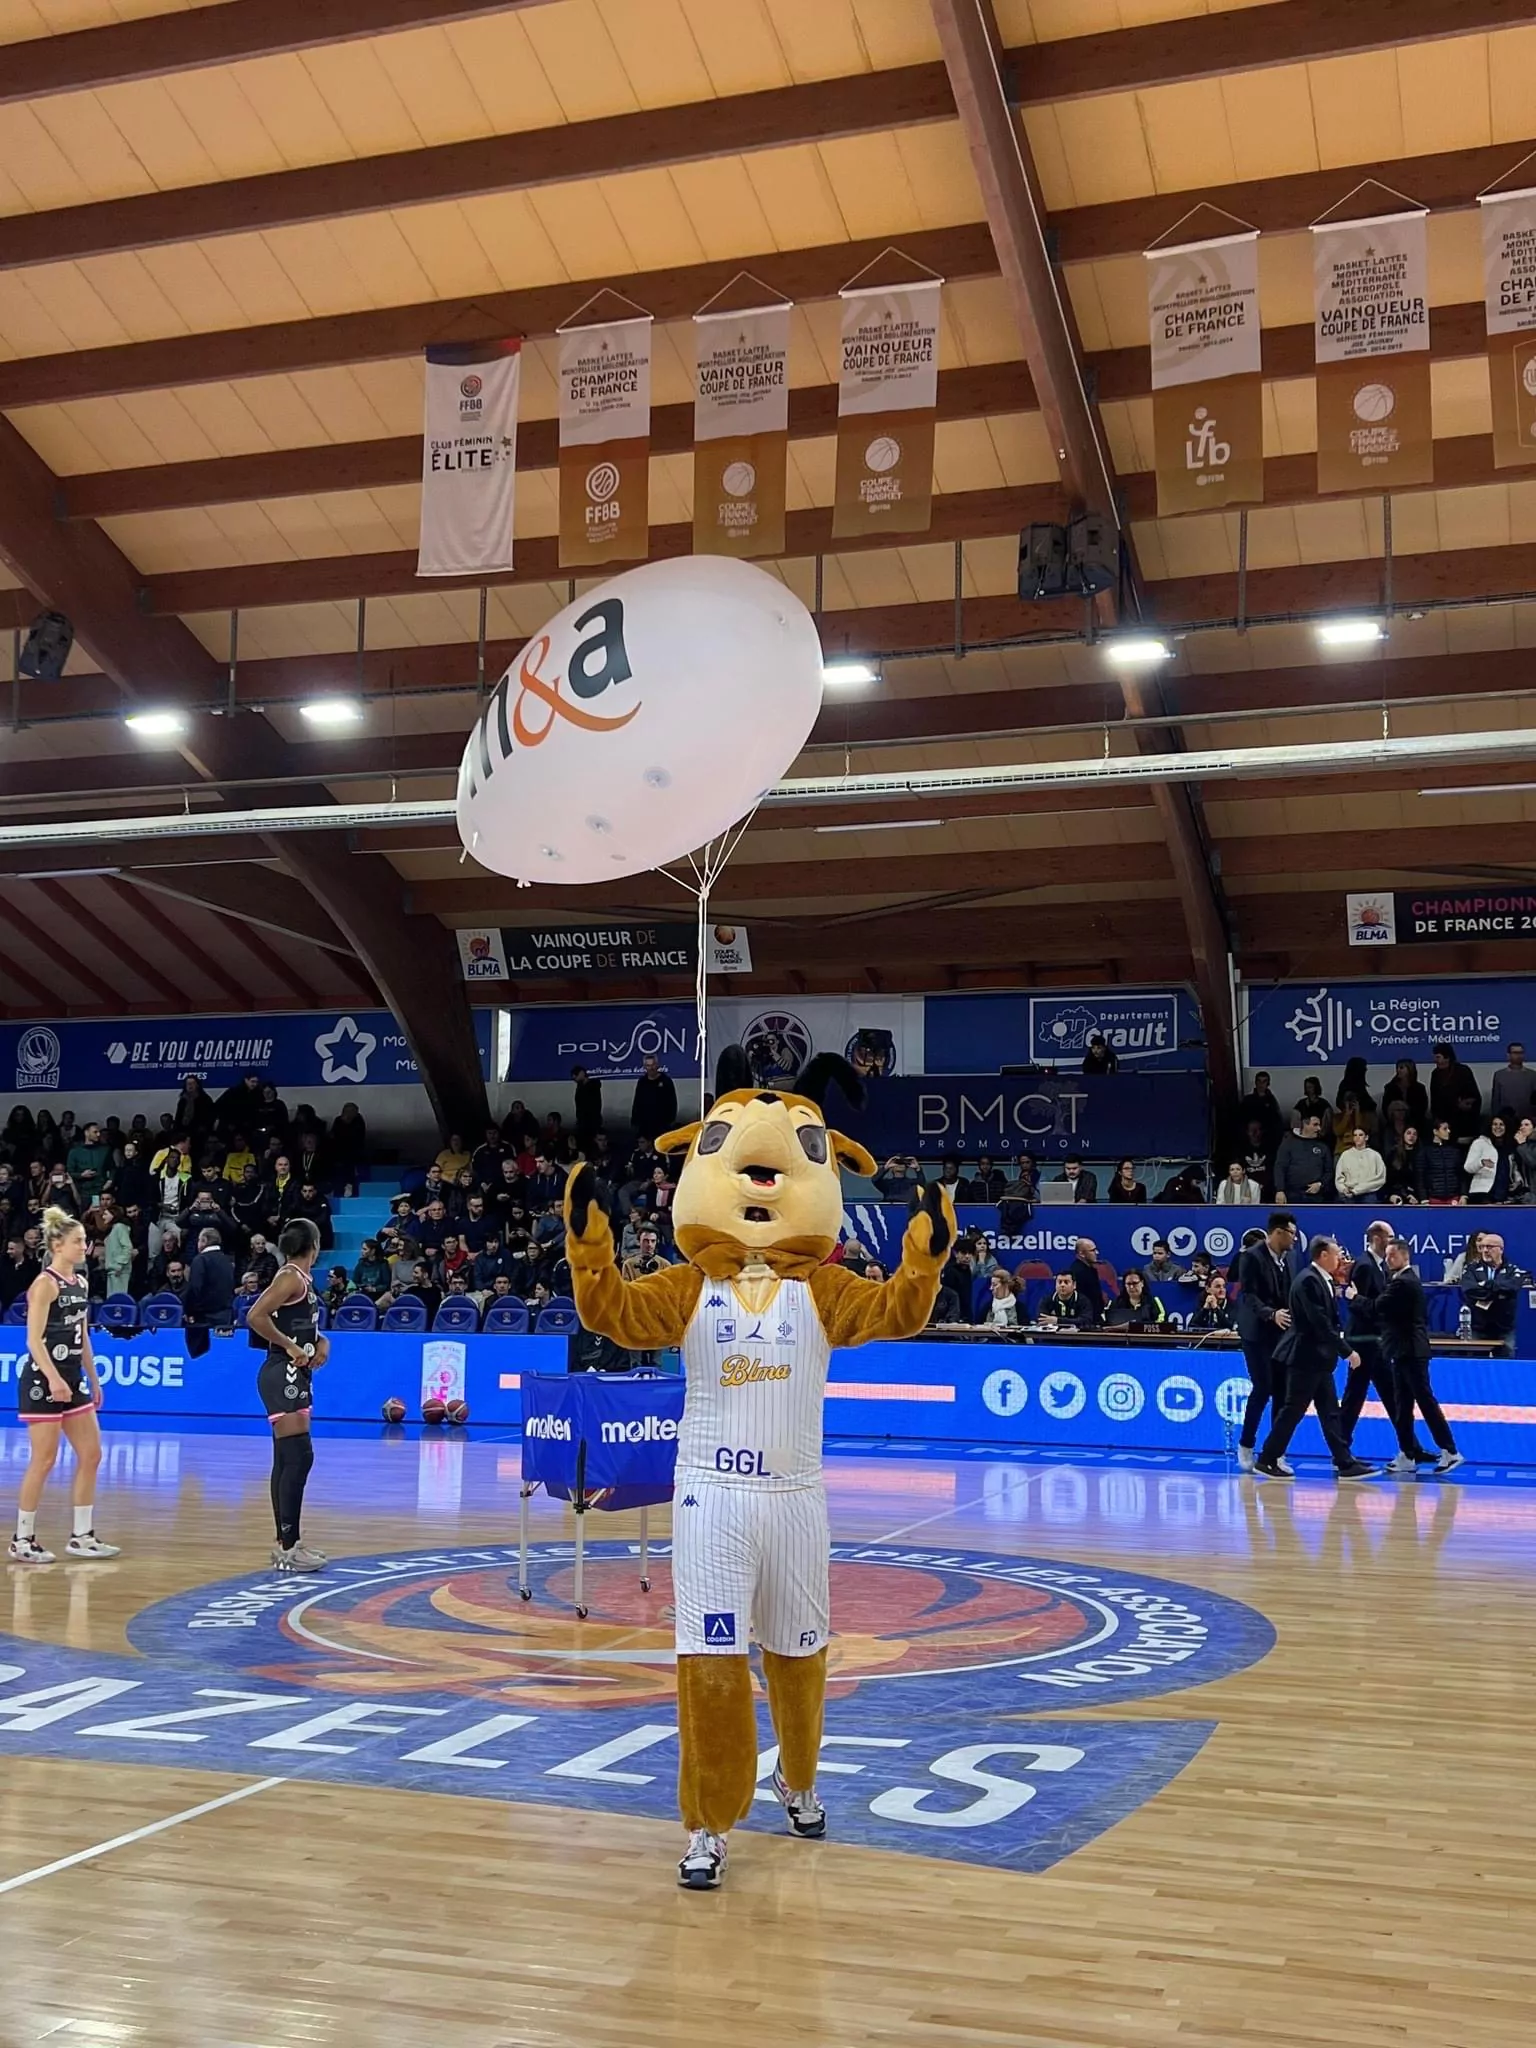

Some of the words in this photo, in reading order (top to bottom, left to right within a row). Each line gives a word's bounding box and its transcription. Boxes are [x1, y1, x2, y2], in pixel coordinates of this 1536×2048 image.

[1503, 229, 1536, 241] BASKE
[1333, 260, 1370, 271] BASKET
[1373, 254, 1407, 265] LATTES
[1337, 263, 1405, 279] MONTPELLIER
[1331, 271, 1407, 288] MÉDITERRANÉE
[1500, 276, 1536, 292] CHA
[1339, 290, 1403, 305] ASSOCIATION
[1501, 292, 1521, 306] DE
[1165, 301, 1244, 326] CHAMPION
[1321, 298, 1424, 322] VAINQUEUR
[1165, 326, 1183, 339] DE
[1188, 314, 1245, 335] FRANCE
[1321, 320, 1357, 336] COUPE
[1362, 317, 1376, 330] DE
[1381, 311, 1425, 328] FRANCE
[844, 337, 932, 357] VAINQUEUR
[843, 357, 875, 370] COUPE
[878, 354, 890, 366] DE
[894, 350, 932, 365] FRANCE
[571, 369, 638, 388] CHAMPION
[701, 361, 783, 381] VAINQUEUR
[571, 388, 586, 400] DE
[590, 381, 638, 398] FRANCE
[700, 381, 729, 395] COUPE
[733, 378, 745, 390] DE
[748, 373, 784, 389] FRANCE
[430, 441, 452, 449] CLUB
[432, 449, 493, 471] ÉLITE
[585, 501, 621, 524] FFBB
[1415, 920, 1438, 933] DE
[1444, 917, 1515, 932] FRANCE
[531, 931, 632, 949] VAINQUEUR
[636, 930, 657, 945] DE
[1355, 930, 1388, 940] BLMA
[468, 963, 501, 976] BLMA
[510, 956, 532, 970] LA
[536, 954, 592, 969] COUPE
[596, 952, 617, 968] DE
[621, 951, 688, 967] FRANCE
[1370, 999, 1386, 1011] La
[1390, 997, 1440, 1012] Région
[1370, 1010, 1500, 1033] Occitanie
[1370, 1034, 1419, 1046] Pyrénées
[1428, 1033, 1500, 1044] Méditerranée
[131, 1041, 152, 1062] BE
[159, 1041, 189, 1061] YOU
[193, 1039, 273, 1061] COACHING
[19, 1072, 57, 1086] GAZELLES
[918, 1094, 1089, 1134] BMCT
[919, 1139, 1090, 1149] PROMOTION
[720, 1354, 792, 1387] Blma
[525, 1414, 572, 1441] molten
[601, 1415, 681, 1443] molte
[188, 1575, 338, 1628] BASKET
[333, 1546, 590, 1575] LATTES
[627, 1545, 1102, 1586] MTPELLIER
[1017, 1585, 1209, 1689] ASSOCIATION
[0, 1663, 1086, 1828] AZELLES
